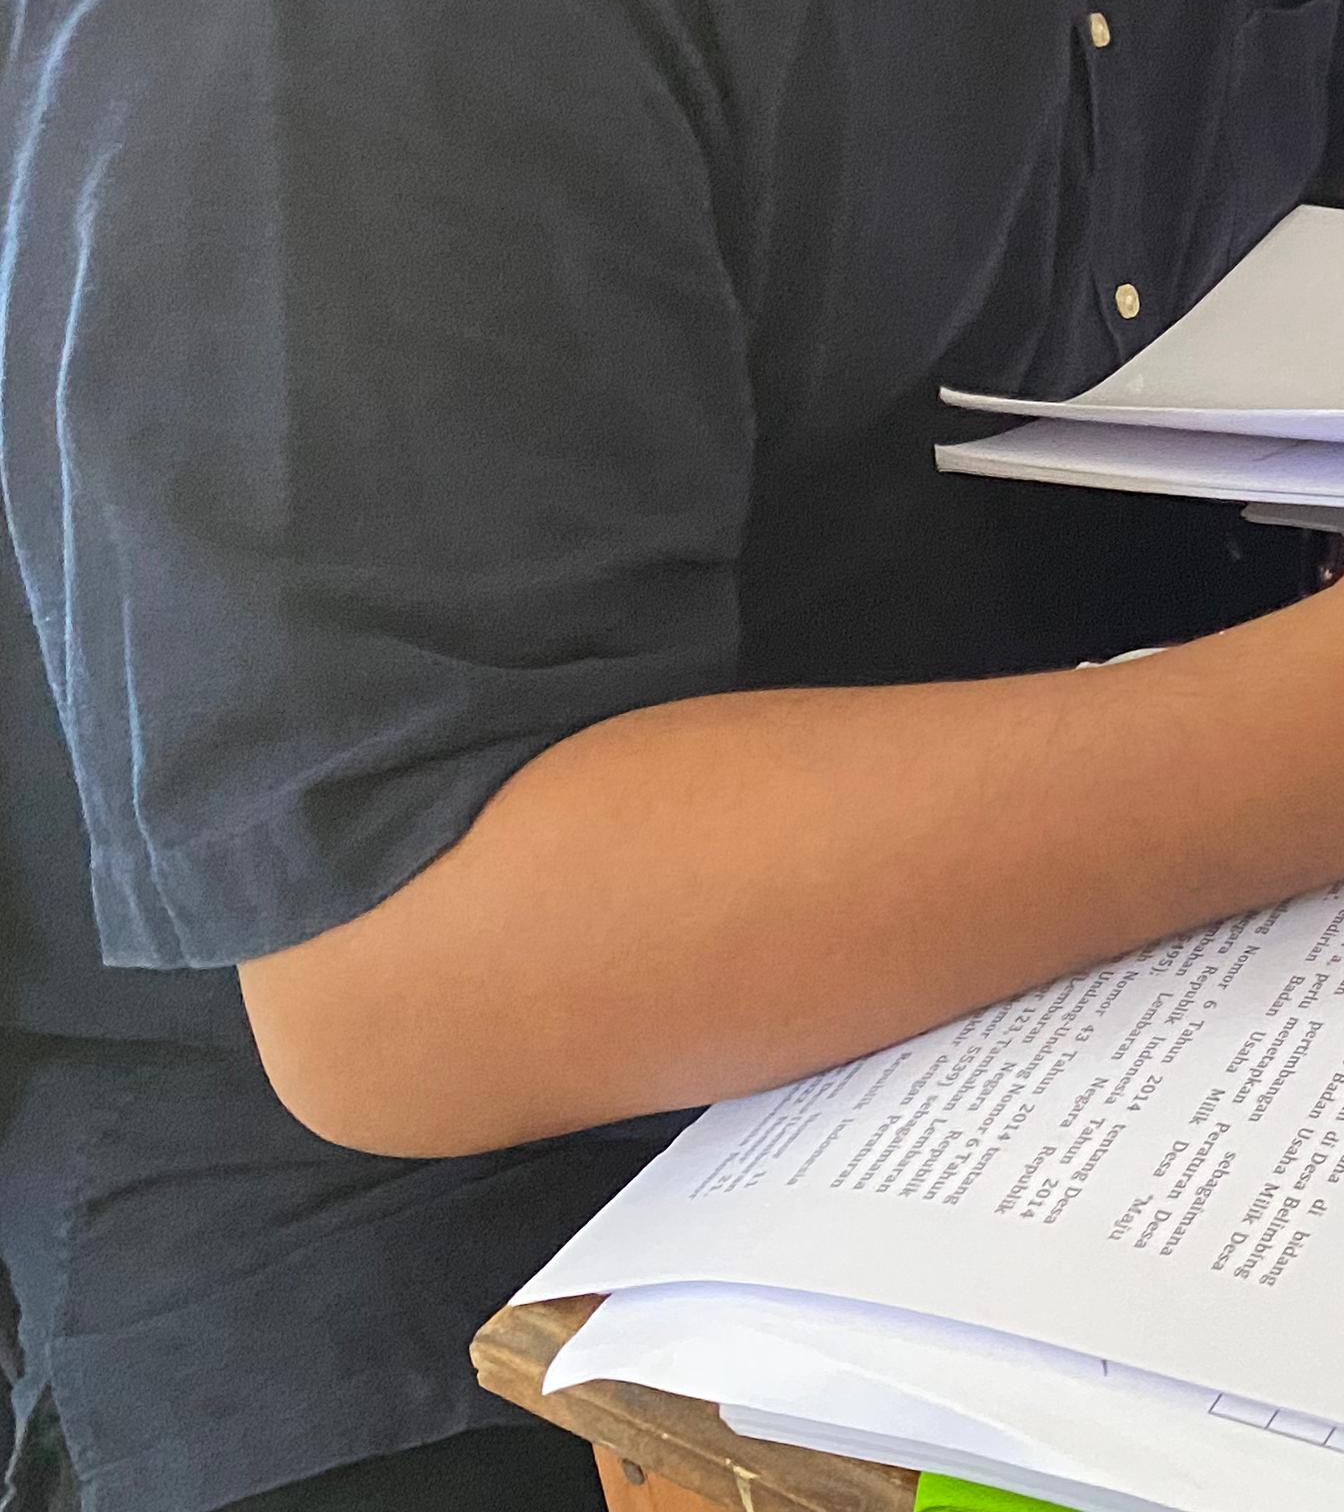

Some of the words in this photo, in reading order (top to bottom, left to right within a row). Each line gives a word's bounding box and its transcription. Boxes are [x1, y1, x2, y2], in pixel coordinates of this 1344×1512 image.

[1174, 921, 1221, 976] mbahan
[1217, 944, 1261, 990] Nomor
[1095, 970, 1140, 1016] Nomor
[1163, 965, 1218, 1024] Republik
[1202, 999, 1217, 1009] 6
[1264, 975, 1305, 1016] Badan
[1297, 972, 1330, 1008] perlu
[980, 1003, 1011, 1040] omor
[1015, 971, 1114, 1079] Undang-Undang
[1074, 1024, 1094, 1042] 43
[1110, 992, 1174, 1060] Lembaran
[1160, 1020, 1204, 1063] Tahun
[941, 1037, 1012, 1111] Tambahan
[1031, 1050, 1078, 1094] Tahun
[1103, 1036, 1167, 1104] Indonesia
[1225, 1031, 1266, 1073] Usaha
[1231, 1016, 1299, 1103] menetapkan
[1247, 1020, 1324, 1121] pertimbangan
[899, 1054, 949, 1105] dengan
[966, 1061, 1017, 1111] Negara
[1059, 1076, 1109, 1127] Negara
[1126, 1074, 1163, 1111] 2014
[976, 1083, 1026, 1135] Nomor
[996, 1103, 1035, 1141] 2014
[1188, 1088, 1225, 1125] Milik
[829, 1114, 902, 1188] Peraturan
[852, 1095, 938, 1189] sebagaimana
[875, 1117, 948, 1192] Lembaran
[964, 1137, 980, 1148] 6
[1059, 1117, 1106, 1164] Tahun
[1070, 1123, 1126, 1182] tentang
[1152, 1140, 1190, 1177] Desa
[1166, 1121, 1230, 1199] Peraturan
[1272, 1127, 1314, 1174] Usaha
[1320, 1130, 1339, 1148] di
[897, 1129, 963, 1197] Republik
[921, 1151, 972, 1199] Tahun
[941, 1146, 1001, 1205] tentang
[993, 1145, 1057, 1214] Republik
[1292, 1151, 1328, 1190] Desa
[1019, 1177, 1059, 1218] 2014
[1042, 1186, 1082, 1224] Desa
[1159, 1151, 1236, 1255] sebagaimana
[1241, 1182, 1280, 1224] Milik
[1307, 1198, 1327, 1216] di
[1133, 1209, 1172, 1248] Desa
[1210, 1231, 1249, 1270] Desa
[1233, 1196, 1301, 1279] Belimbing
[1258, 1230, 1310, 1286] bidang
